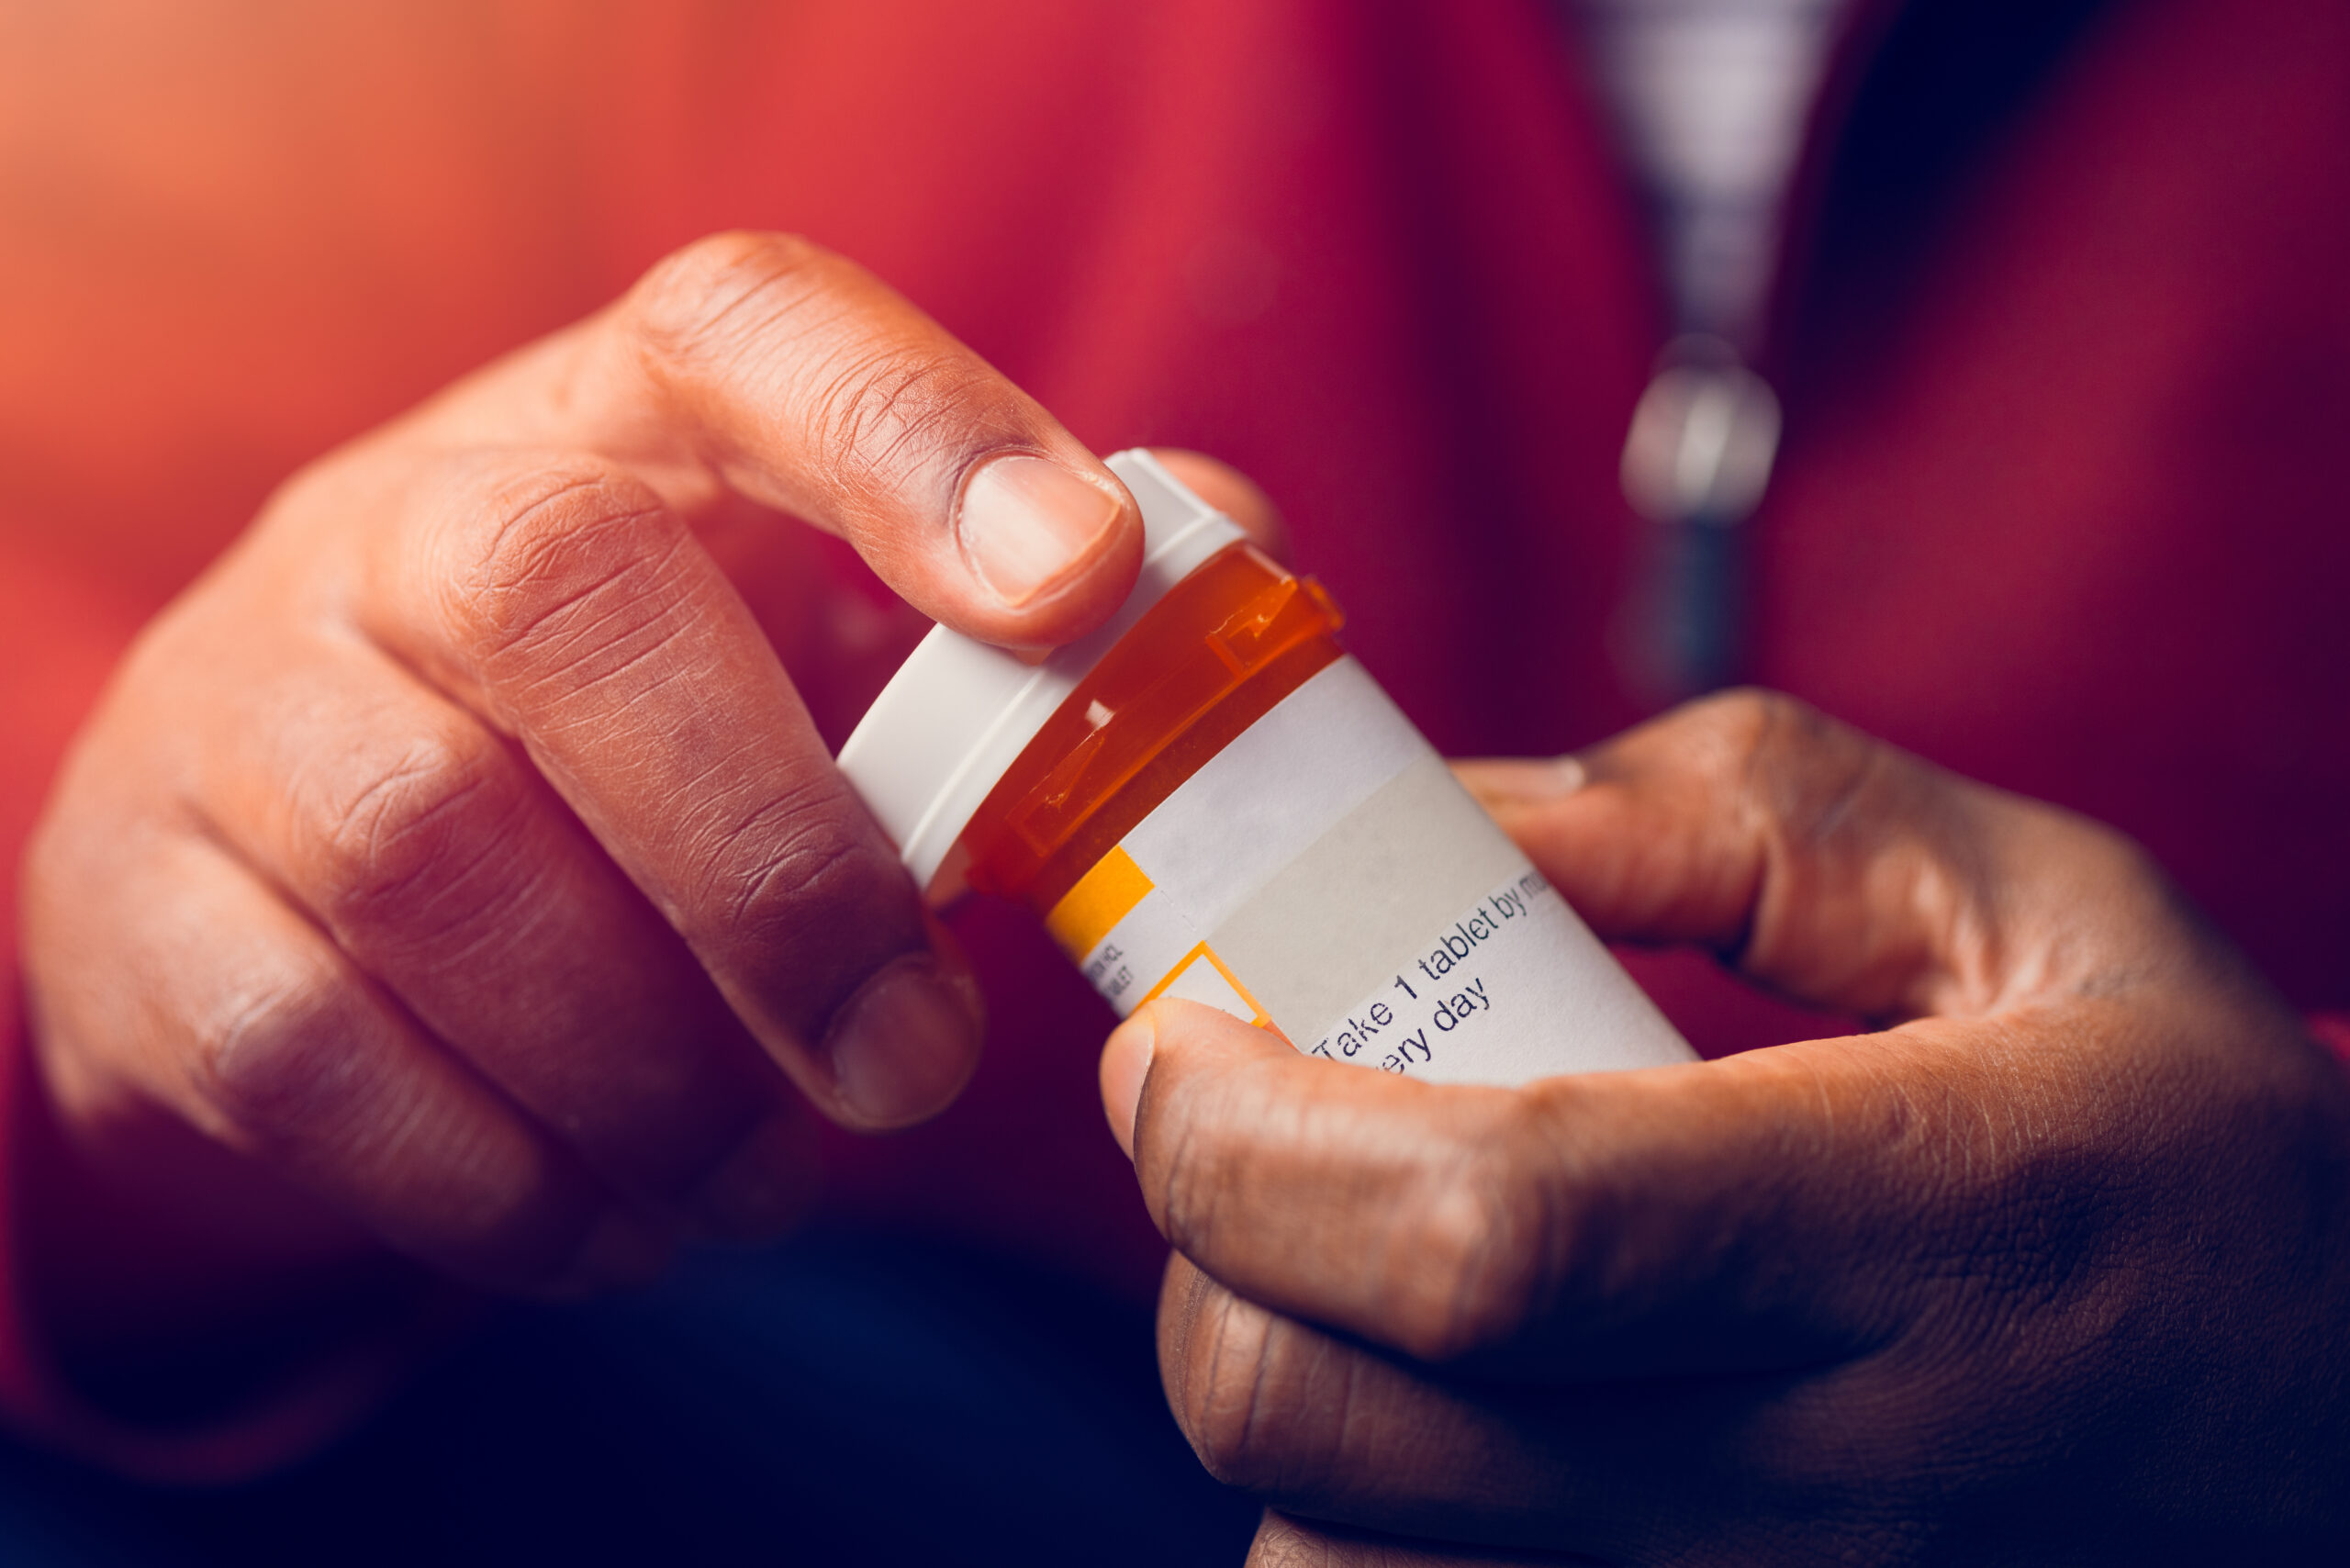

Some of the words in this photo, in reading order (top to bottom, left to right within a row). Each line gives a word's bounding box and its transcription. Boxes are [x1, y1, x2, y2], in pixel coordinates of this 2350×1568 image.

[1312, 1002, 1393, 1061] Take
[1394, 975, 1417, 999] 1
[1418, 907, 1499, 980] tablet
[1488, 887, 1527, 920] by
[1433, 977, 1490, 1032] day
